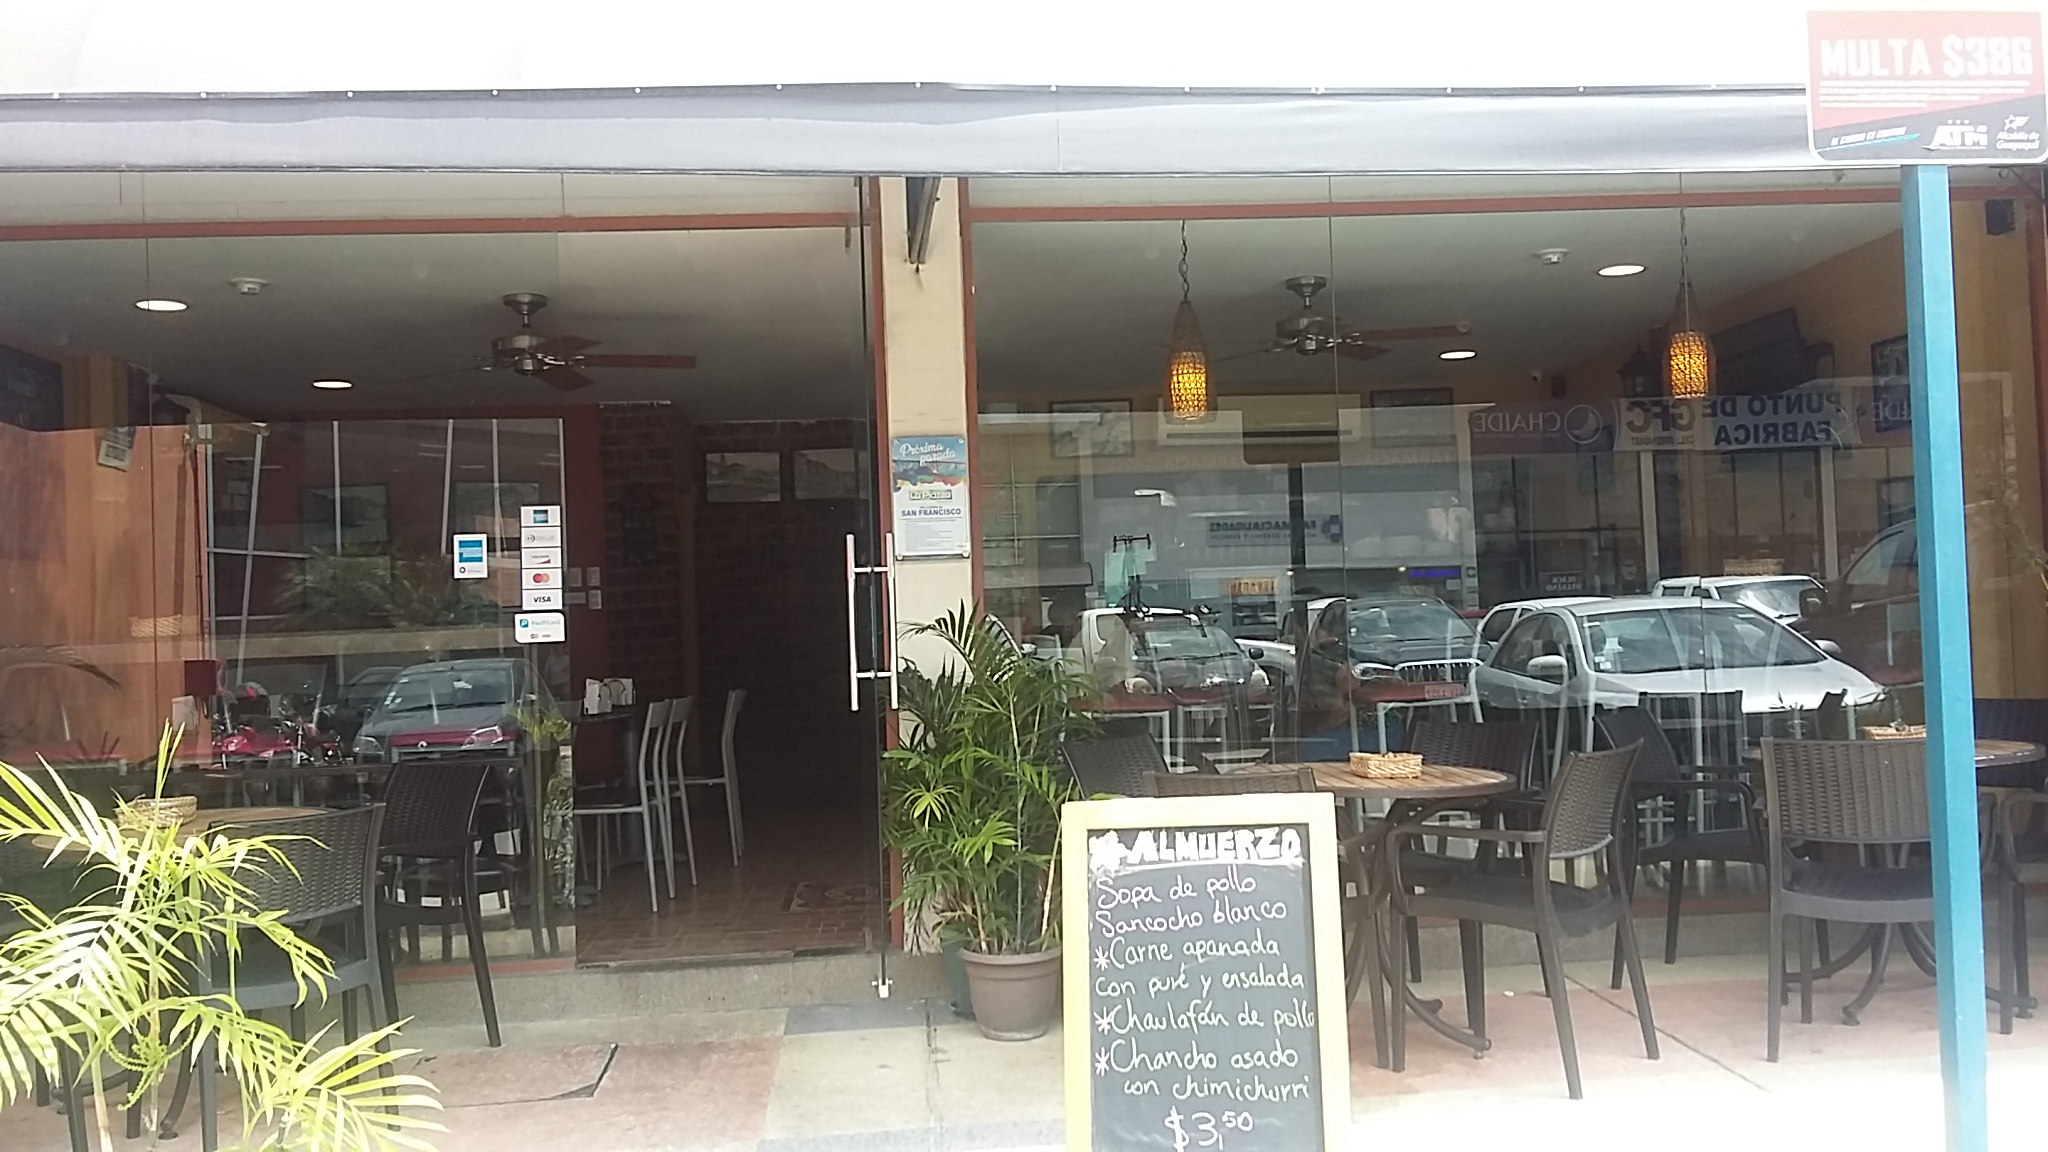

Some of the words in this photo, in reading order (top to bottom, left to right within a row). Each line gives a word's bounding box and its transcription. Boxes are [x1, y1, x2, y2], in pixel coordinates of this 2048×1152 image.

[1820, 38, 1932, 76] MULTA
[1941, 34, 2033, 77] $386
[900, 442, 944, 458] Próxima
[919, 448, 956, 466] parada
[901, 509, 917, 517] SAN
[918, 508, 962, 516] FRANCISCO
[1127, 827, 1303, 864] ALMUERZO
[1097, 877, 1162, 909] Sopa
[1169, 875, 1197, 900] de
[1207, 864, 1256, 898] pollo
[1095, 906, 1203, 937] Sancocho
[1213, 895, 1287, 924] blanco
[1109, 936, 1173, 969] Carne
[1183, 928, 1280, 964] apanada
[1148, 962, 1190, 998] puré
[1200, 975, 1211, 997] y
[1222, 962, 1304, 989] ensalada
[1110, 997, 1229, 1034] Chaulafán
[1238, 1001, 1264, 1027] de
[1273, 997, 1315, 1035] pollo
[1110, 1037, 1217, 1073] Chancho
[1231, 1039, 1299, 1069] asado
[1124, 1080, 1160, 1096] con
[1172, 1074, 1310, 1101] chimichurri
